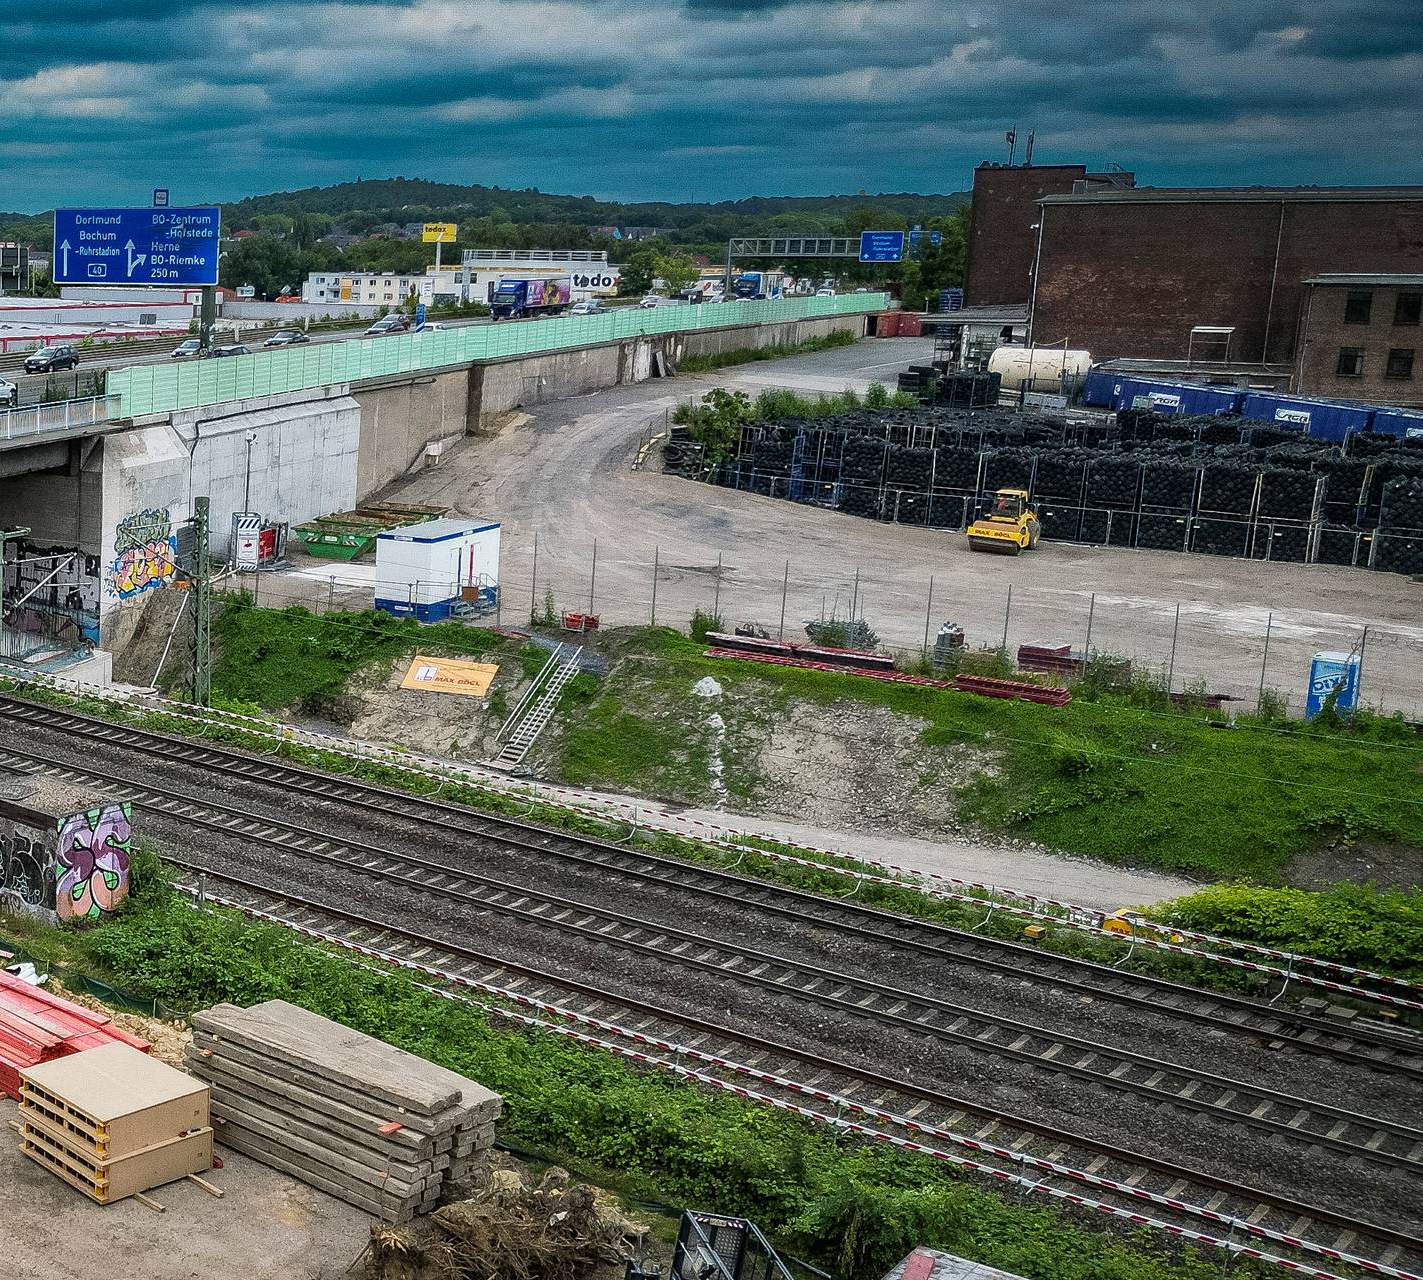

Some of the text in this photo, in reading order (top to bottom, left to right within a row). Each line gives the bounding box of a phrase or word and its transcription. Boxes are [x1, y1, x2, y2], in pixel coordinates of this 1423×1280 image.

[75, 214, 122, 225] Dortmund
[152, 214, 211, 224] BO-Zentrum
[79, 230, 117, 241] Bochum
[75, 246, 120, 256] -Ruhrstadion
[151, 241, 180, 252] Herne
[151, 255, 206, 265] BO-Riemke
[92, 266, 103, 275] 40
[151, 268, 179, 278] 250 m
[434, 676, 455, 684] MAX
